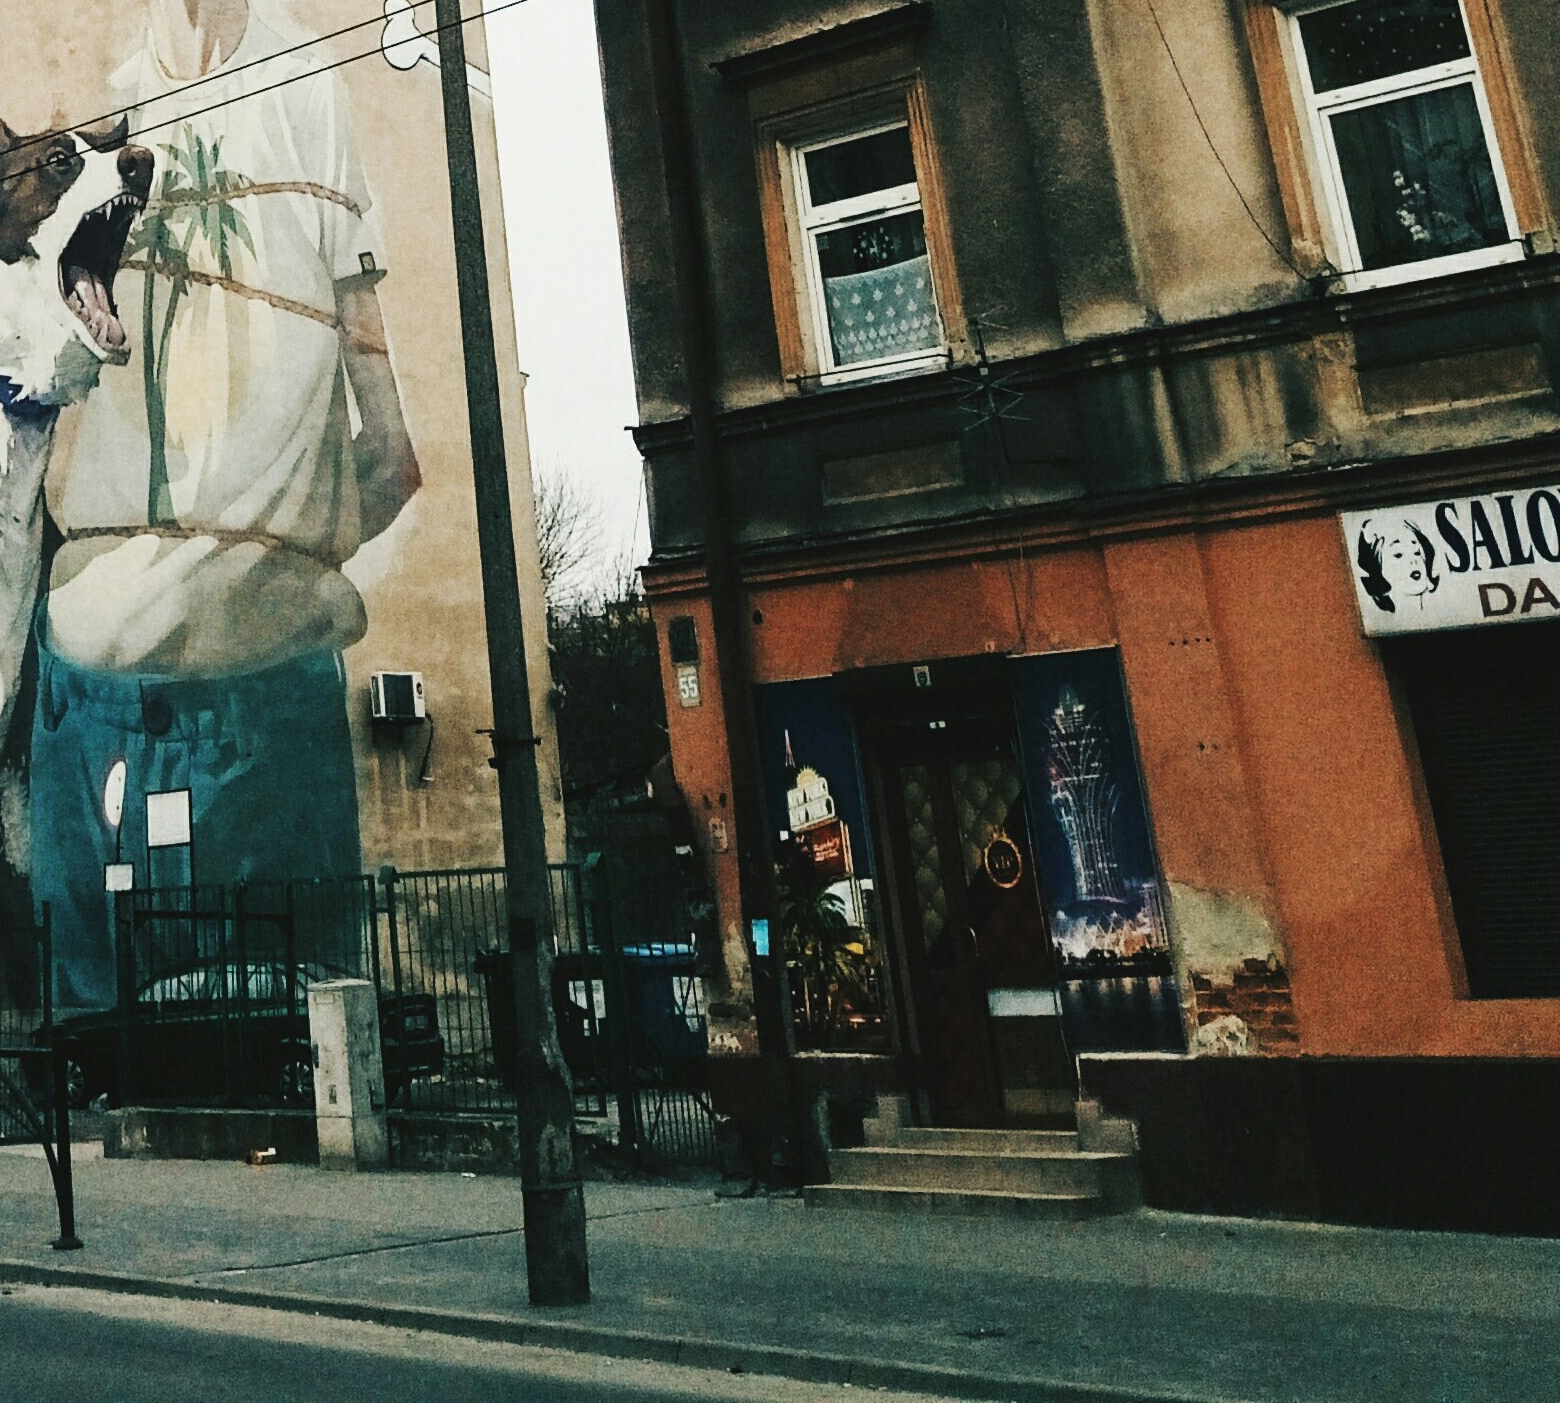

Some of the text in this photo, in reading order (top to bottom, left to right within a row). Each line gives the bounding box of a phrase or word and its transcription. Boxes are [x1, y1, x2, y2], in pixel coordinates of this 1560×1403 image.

[1435, 489, 1560, 573] SALO
[1477, 577, 1560, 618] DA
[680, 676, 700, 699] 55
